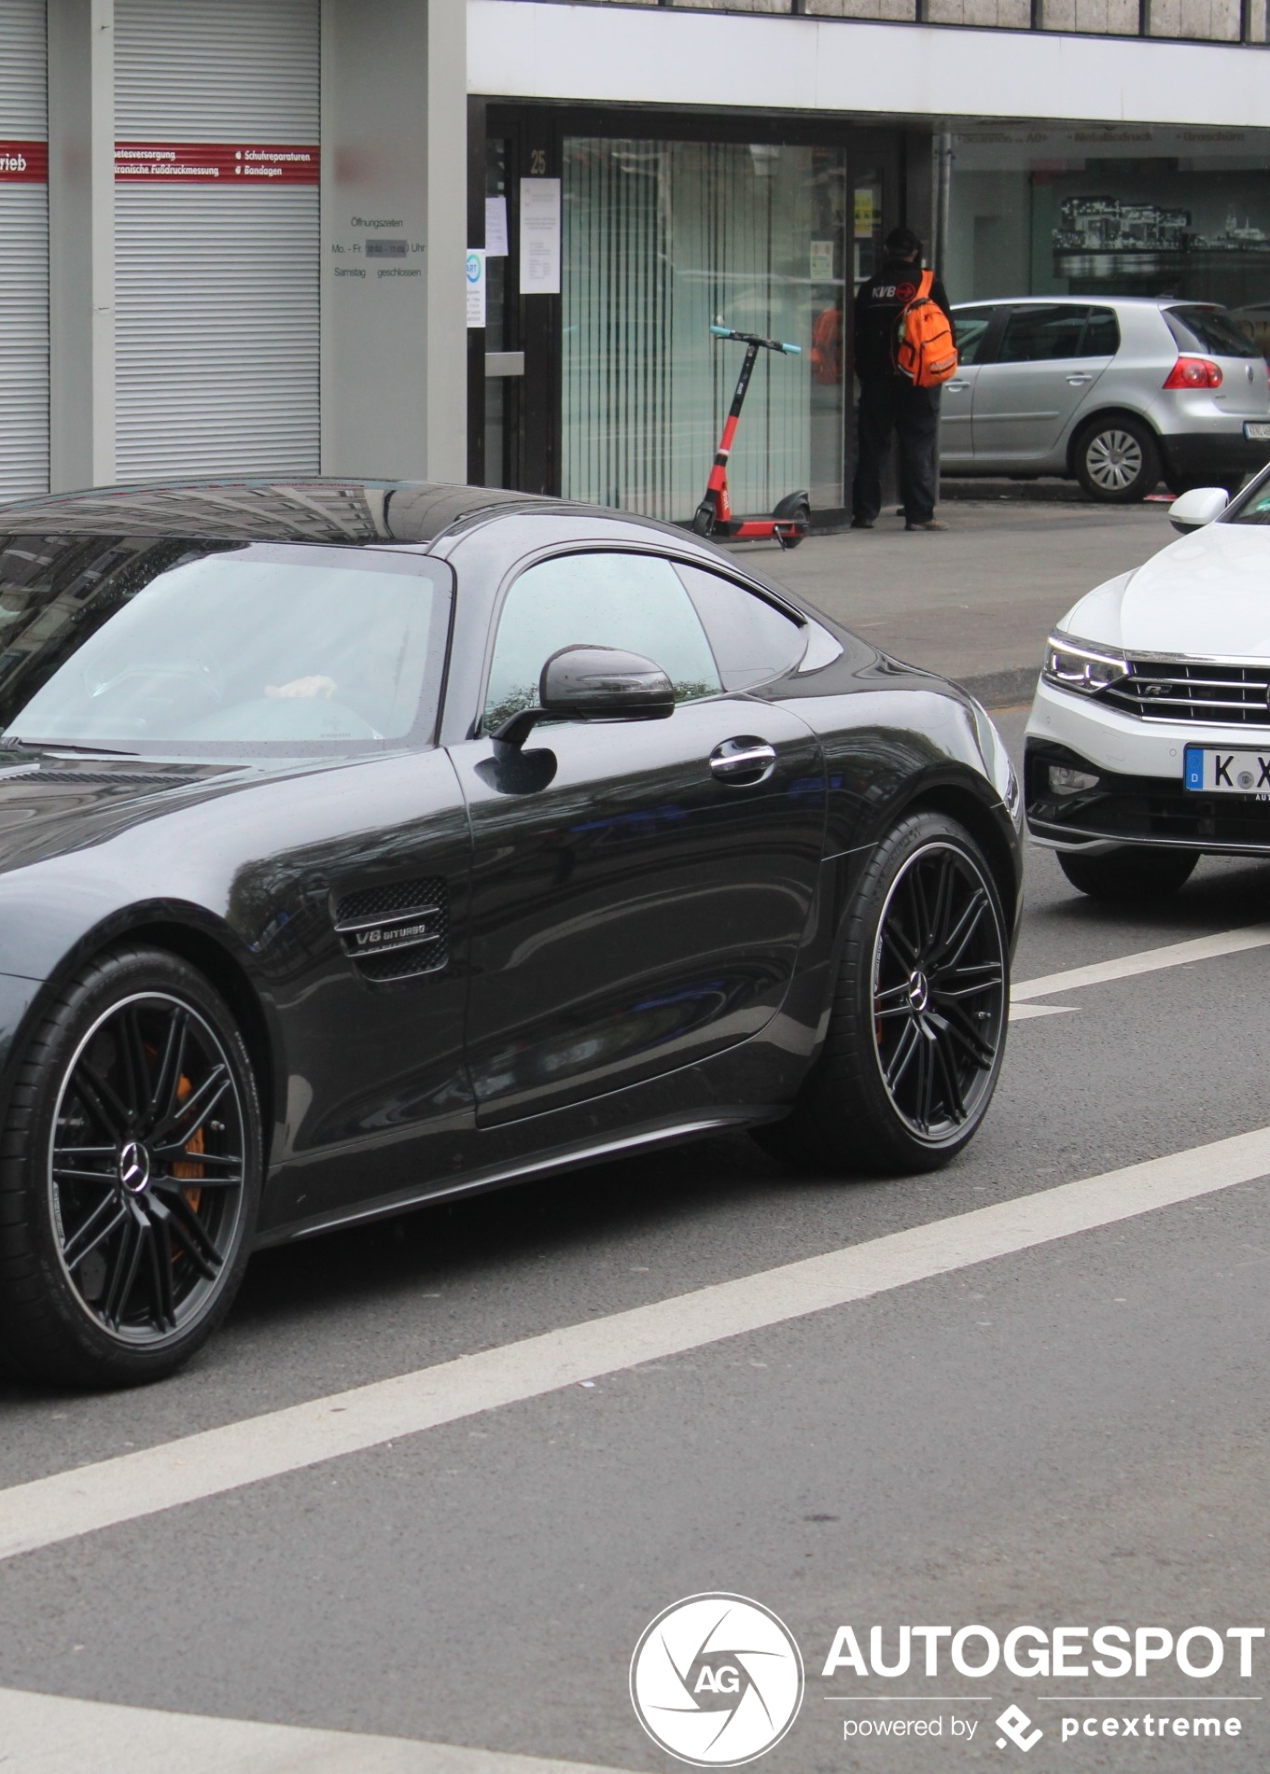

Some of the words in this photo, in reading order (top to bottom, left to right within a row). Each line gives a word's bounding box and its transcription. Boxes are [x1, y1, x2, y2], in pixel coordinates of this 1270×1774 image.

[245, 150, 310, 163] Schuhreparaturen
[530, 149, 546, 175] 25
[244, 165, 282, 177] Bandagen
[351, 216, 403, 229] Öffnungszeiten
[411, 243, 425, 253] Uhr
[335, 267, 366, 279] Samstag
[377, 267, 421, 278] geschlossen
[872, 286, 897, 298] KVB
[1215, 754, 1234, 787] K
[1191, 773, 1199, 783] D
[356, 930, 381, 945] V8
[383, 924, 425, 940] BITURBO
